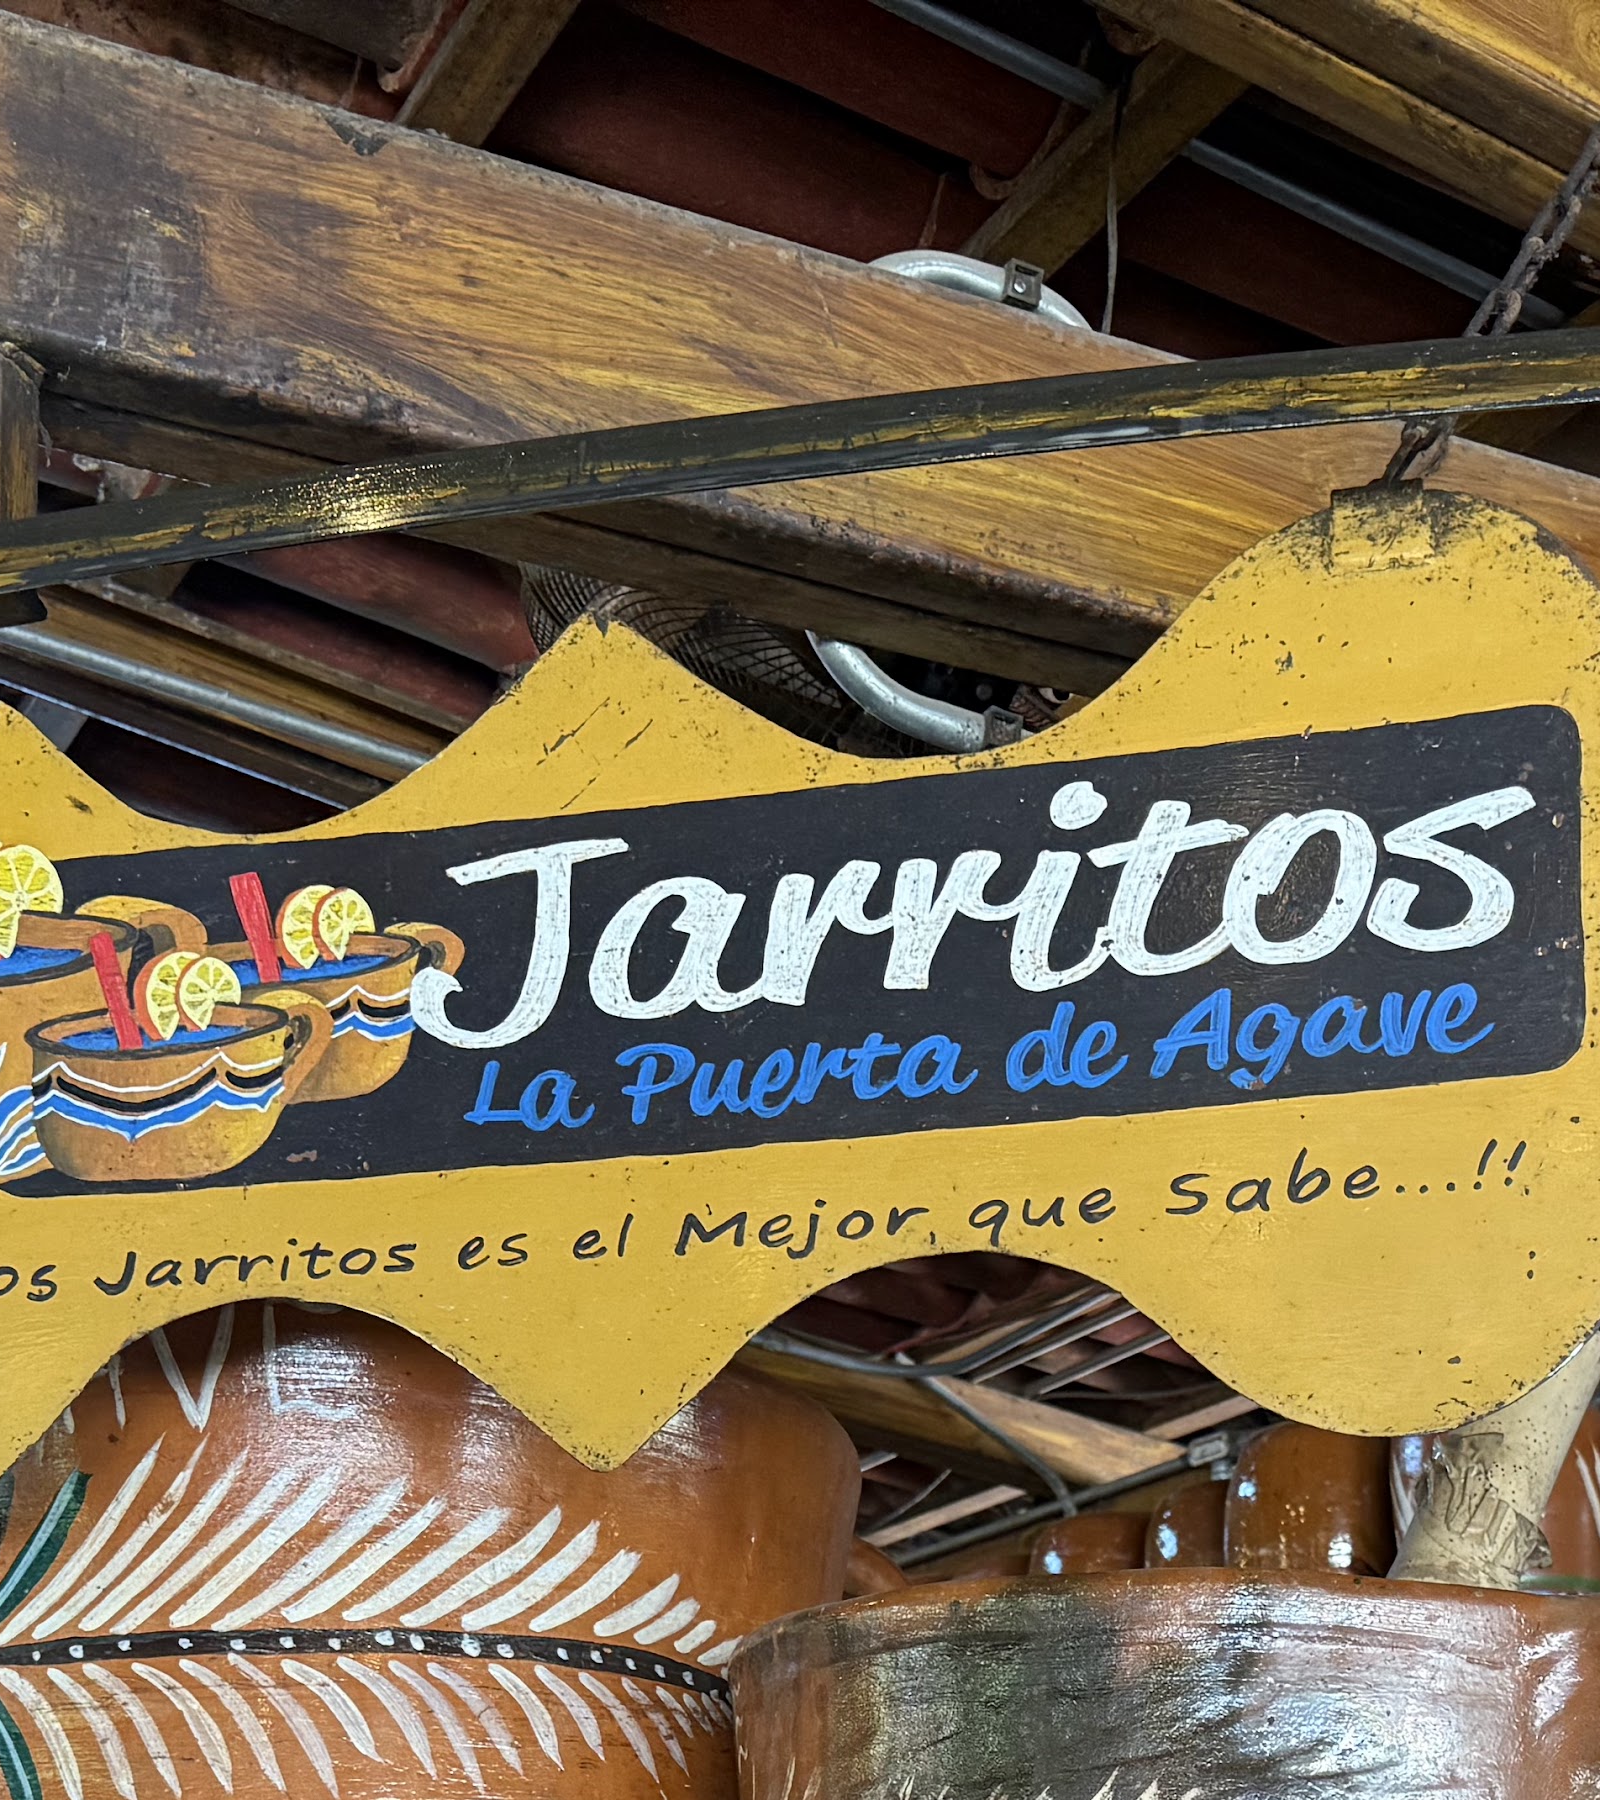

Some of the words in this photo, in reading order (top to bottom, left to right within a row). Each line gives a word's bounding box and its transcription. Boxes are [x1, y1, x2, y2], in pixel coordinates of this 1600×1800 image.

[410, 781, 1536, 1051] Jarritos
[463, 1060, 593, 1131] La
[615, 1032, 977, 1125] Puerta
[1004, 999, 1130, 1095] de
[1149, 982, 1496, 1089] Agave
[93, 1238, 417, 1297] Jarritos
[456, 1228, 530, 1270] es
[571, 1212, 634, 1261] el
[968, 1185, 1119, 1247] que
